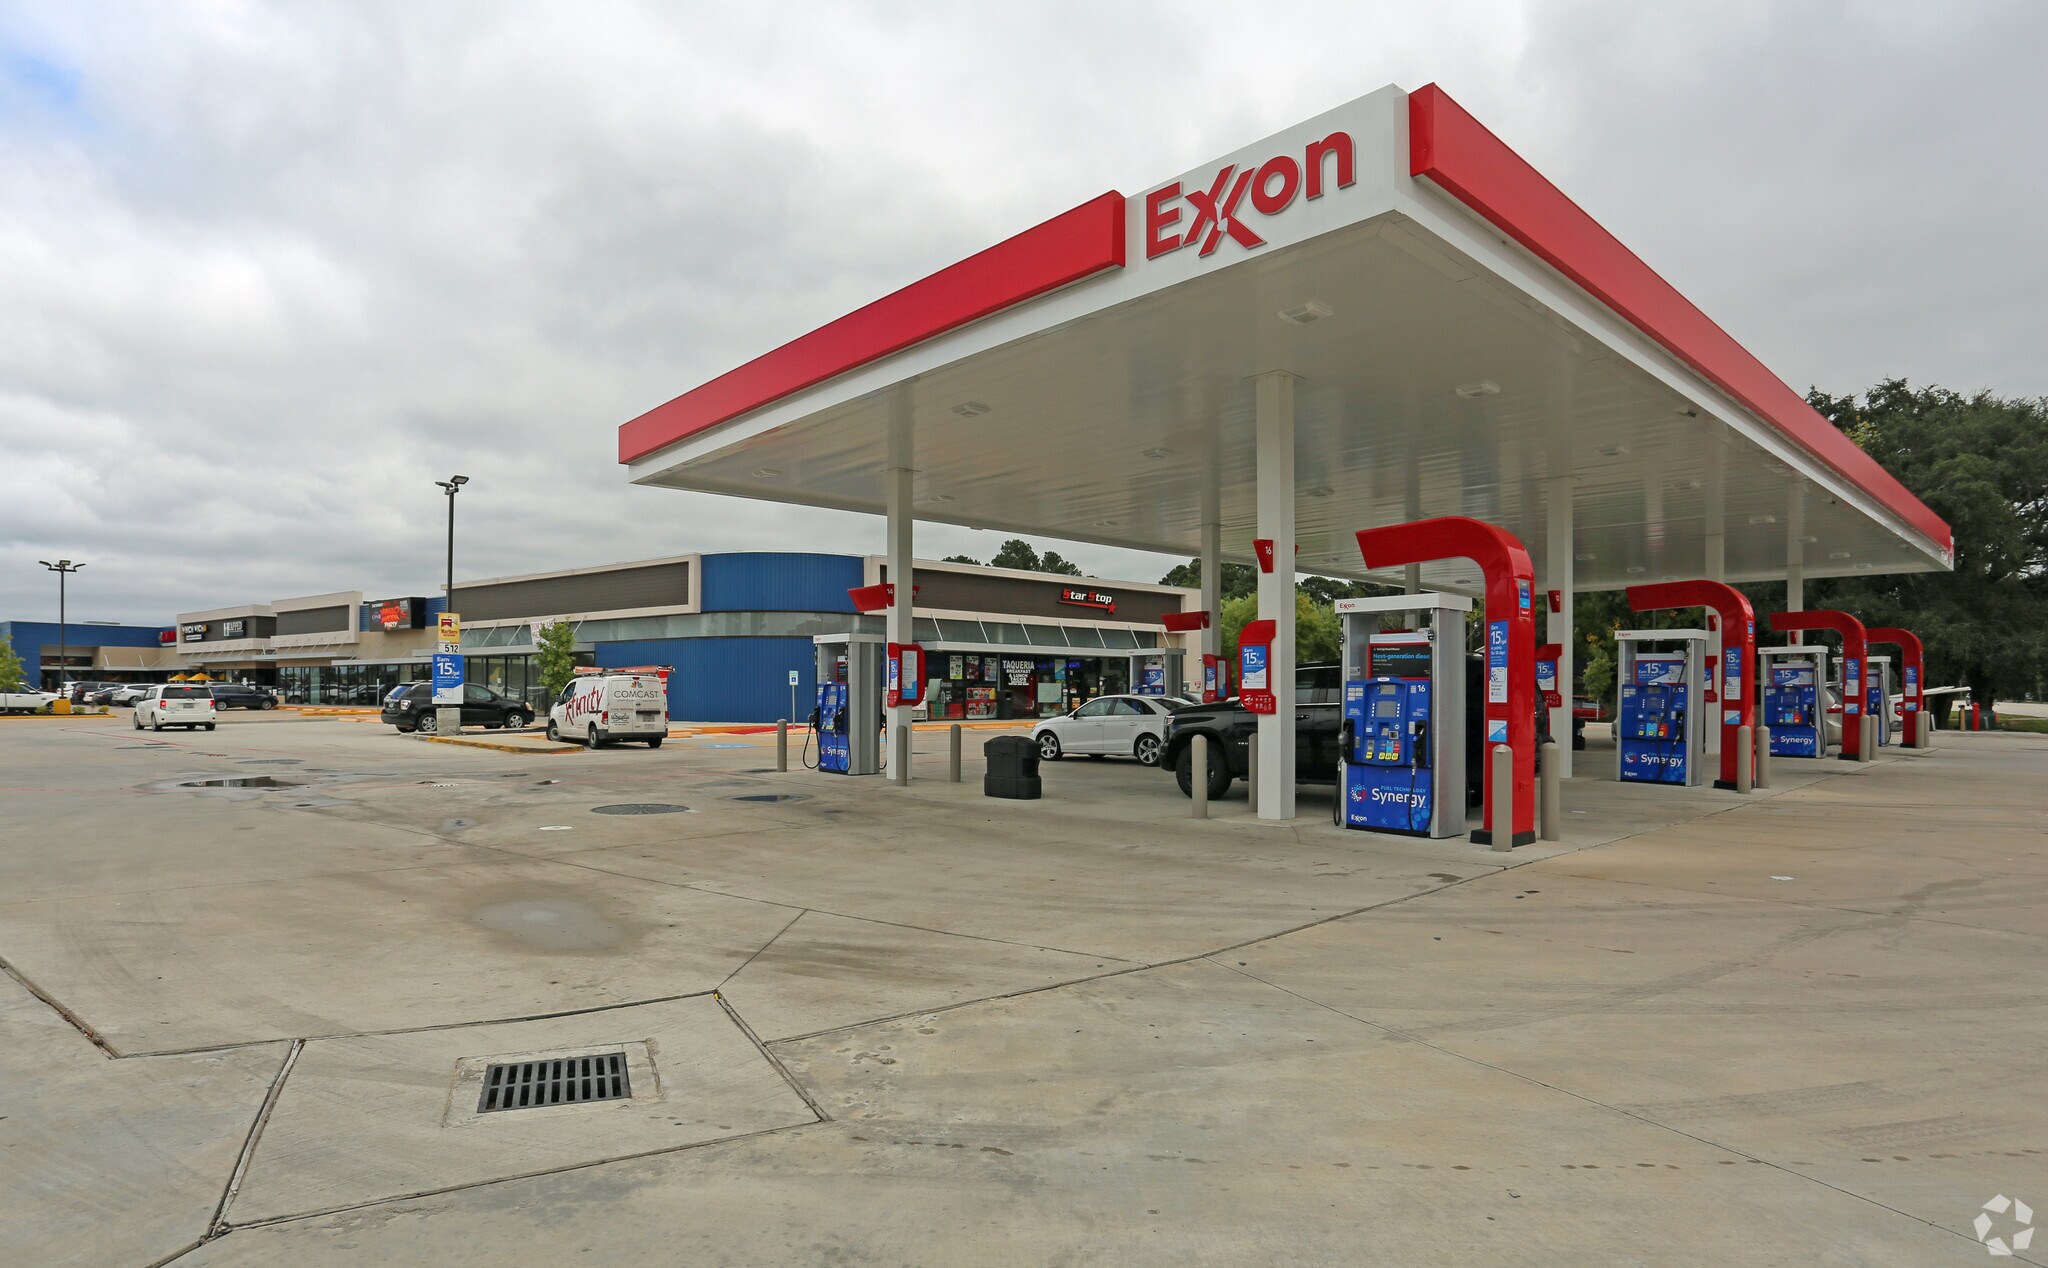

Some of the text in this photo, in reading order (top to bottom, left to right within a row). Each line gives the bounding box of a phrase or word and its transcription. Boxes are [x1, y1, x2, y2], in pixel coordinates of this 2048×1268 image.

[1146, 131, 1357, 261] Exxon
[1265, 546, 1272, 555] 16
[1062, 588, 1113, 605] Star Stop
[444, 644, 459, 653] 512
[1002, 660, 1035, 669] TAQUERIA
[614, 690, 659, 698] COMCAST
[1781, 735, 1814, 745] Synergy
[1371, 788, 1426, 808] Synergy
[1351, 814, 1368, 822] Exxon
